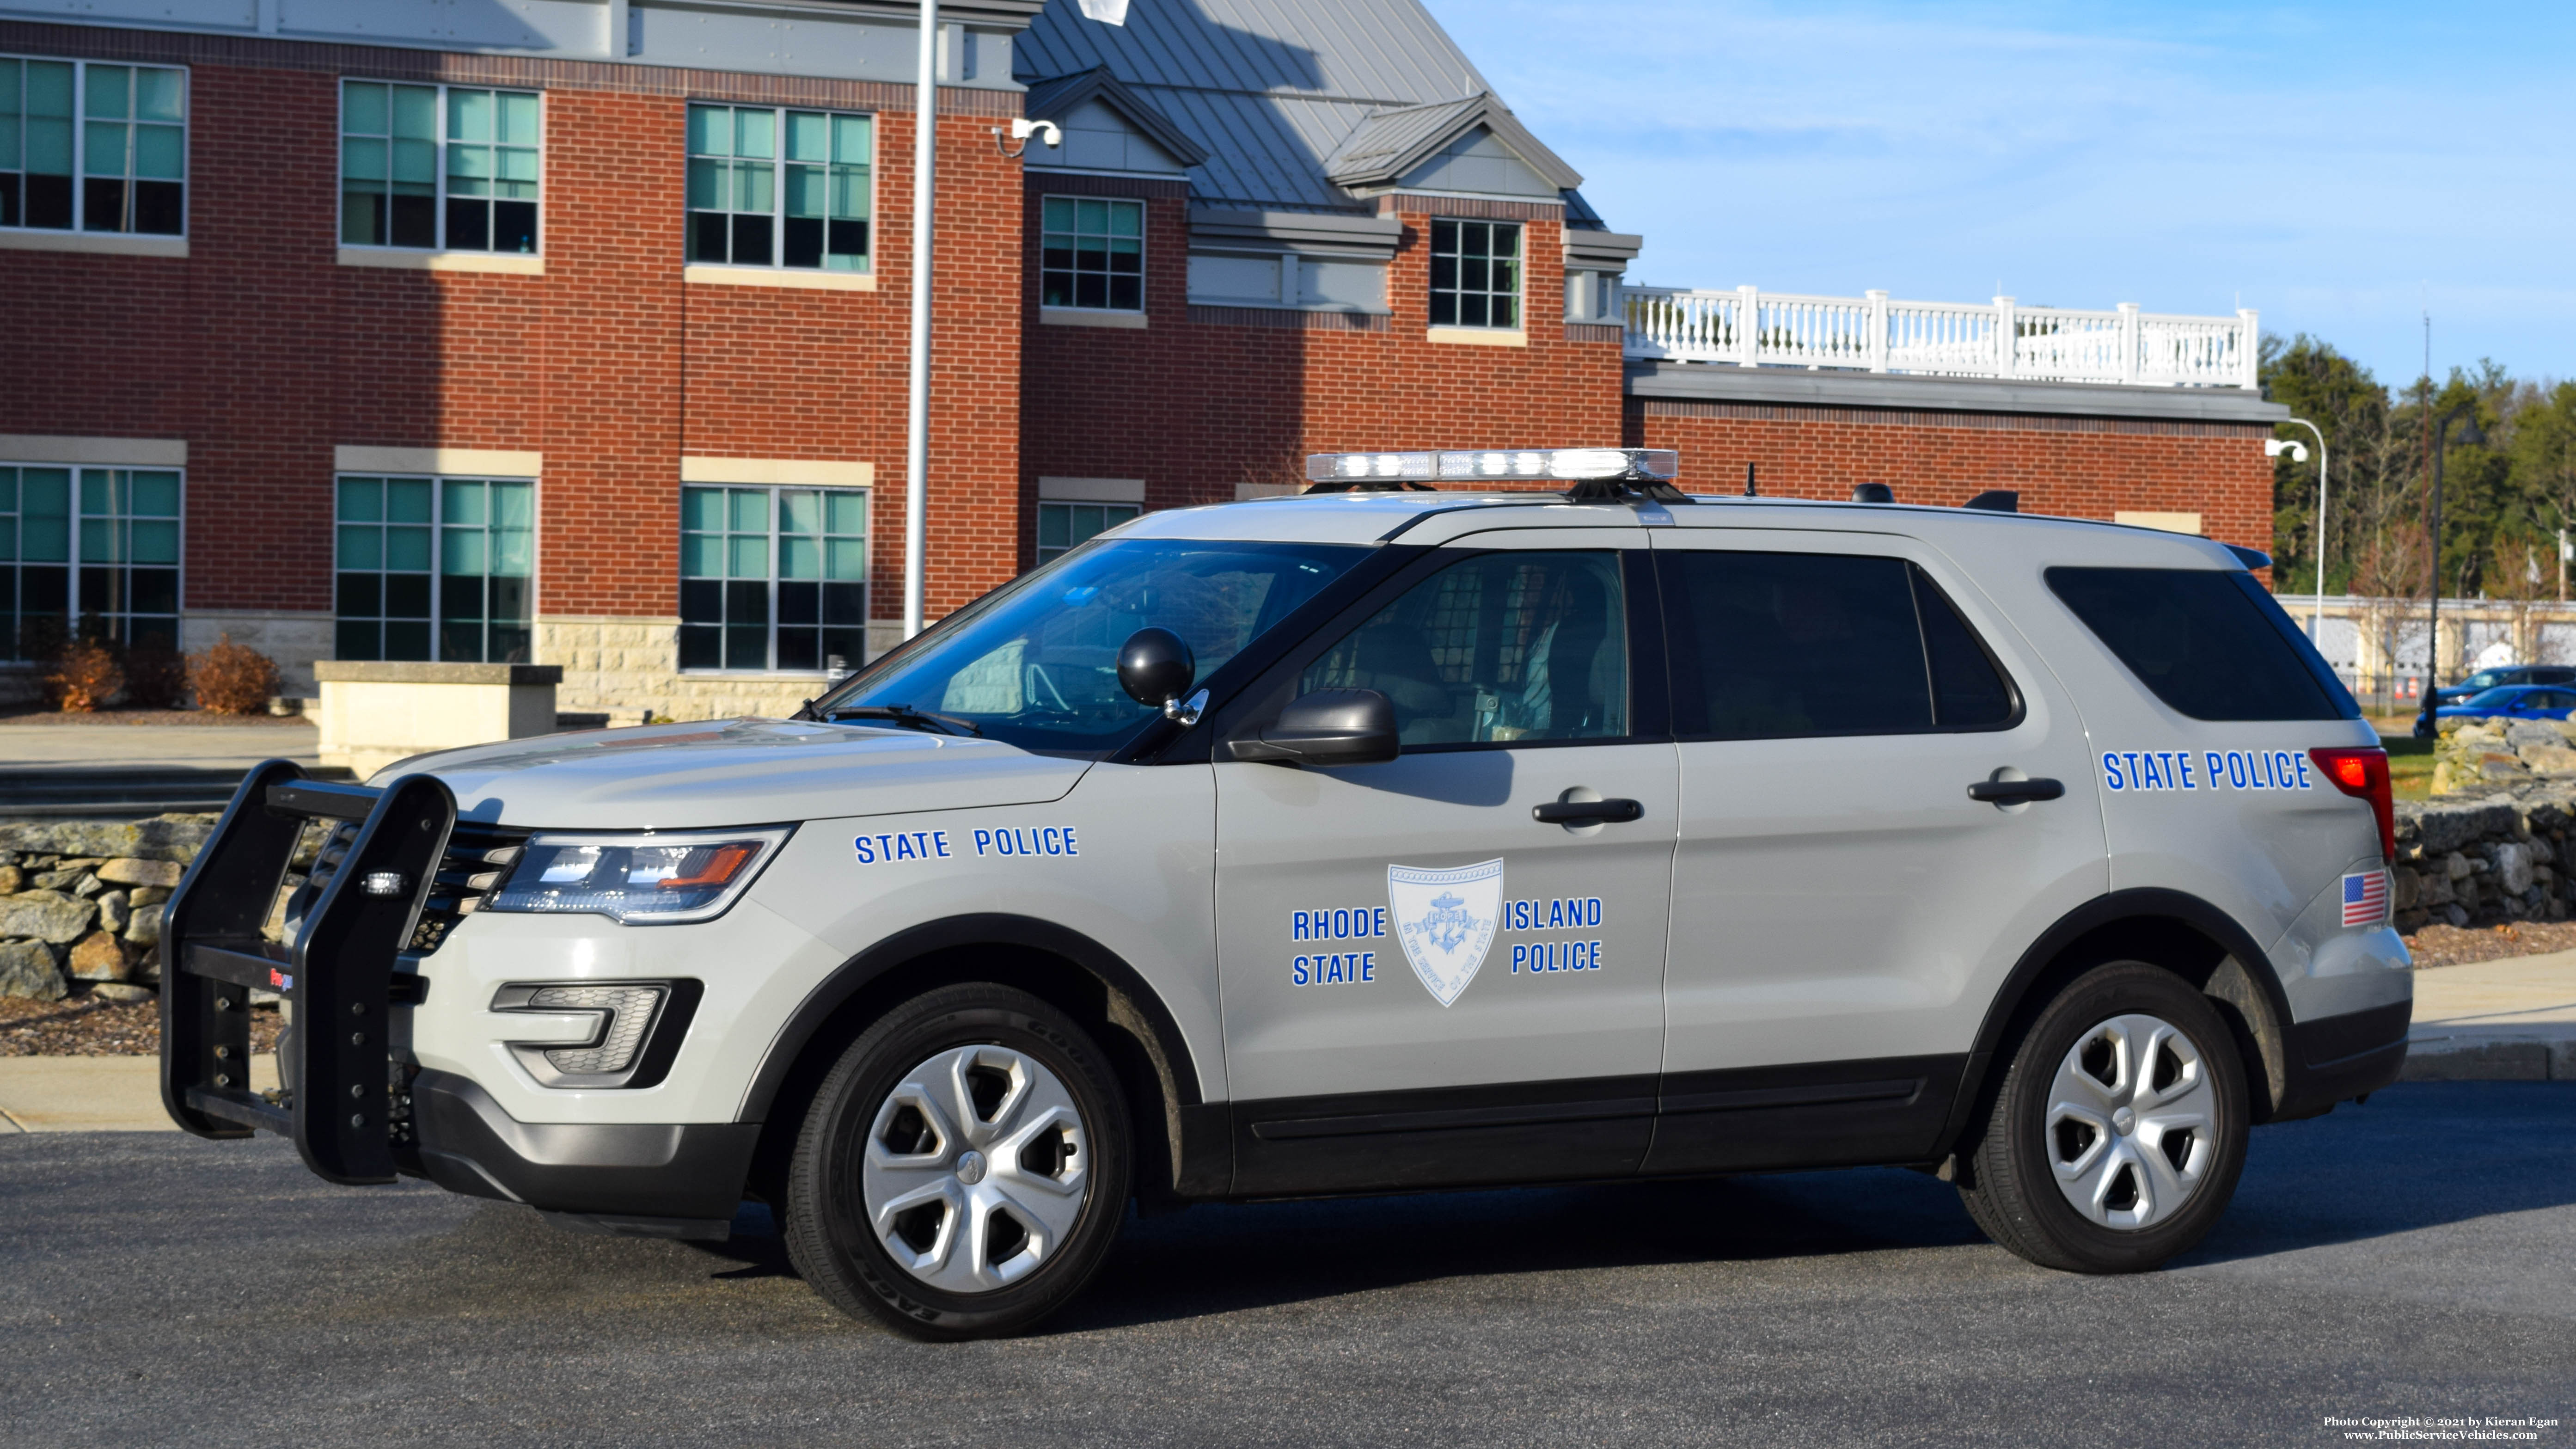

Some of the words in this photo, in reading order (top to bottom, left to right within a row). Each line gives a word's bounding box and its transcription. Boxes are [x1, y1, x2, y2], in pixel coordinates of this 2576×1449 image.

[2101, 751, 2197, 791] STATE
[2203, 750, 2312, 790] POLICE
[854, 829, 953, 865] STATE
[972, 827, 1079, 856] POLICE
[1293, 906, 1386, 941] RHODE
[1505, 897, 1602, 931] ISLAND
[1293, 951, 1375, 986] STATE
[1511, 940, 1601, 975] POLICE
[1403, 922, 1413, 934] IN
[1408, 935, 1422, 957] THE
[1417, 956, 1446, 992] SERVICE
[1450, 975, 1461, 990] OF
[1461, 954, 1477, 974] THE
[1475, 919, 1492, 952] STATE
